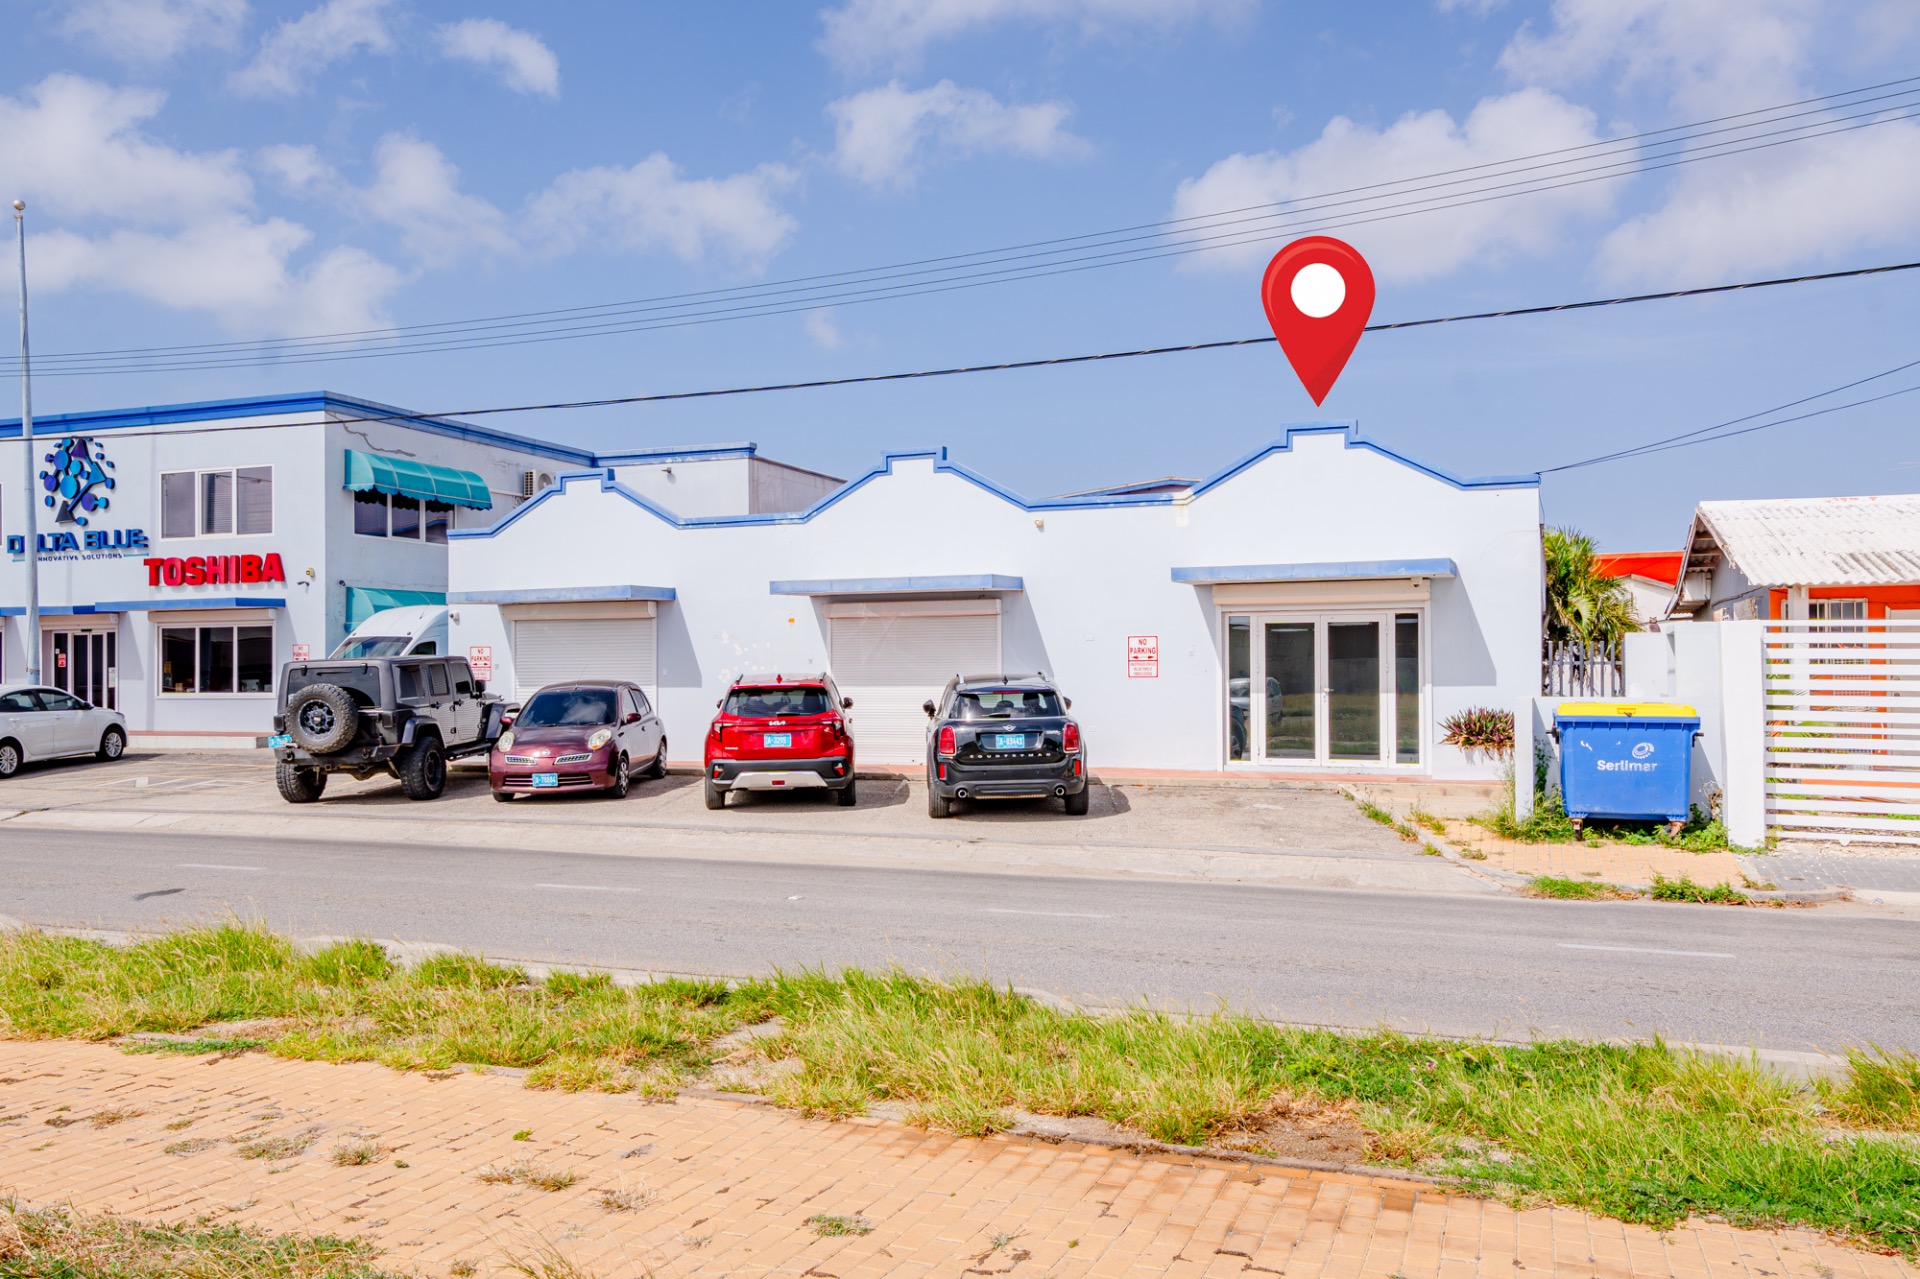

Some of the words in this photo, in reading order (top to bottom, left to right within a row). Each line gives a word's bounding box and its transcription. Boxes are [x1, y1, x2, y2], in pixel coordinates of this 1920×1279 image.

[7, 532, 80, 554] DLTA
[84, 529, 149, 550] BLUE
[143, 553, 285, 586] TOSHIBA
[1138, 638, 1147, 646] NO
[1129, 647, 1157, 655] PARKING
[968, 752, 1051, 760] COUNTRYMAN
[1597, 759, 1658, 773] Serlimar
